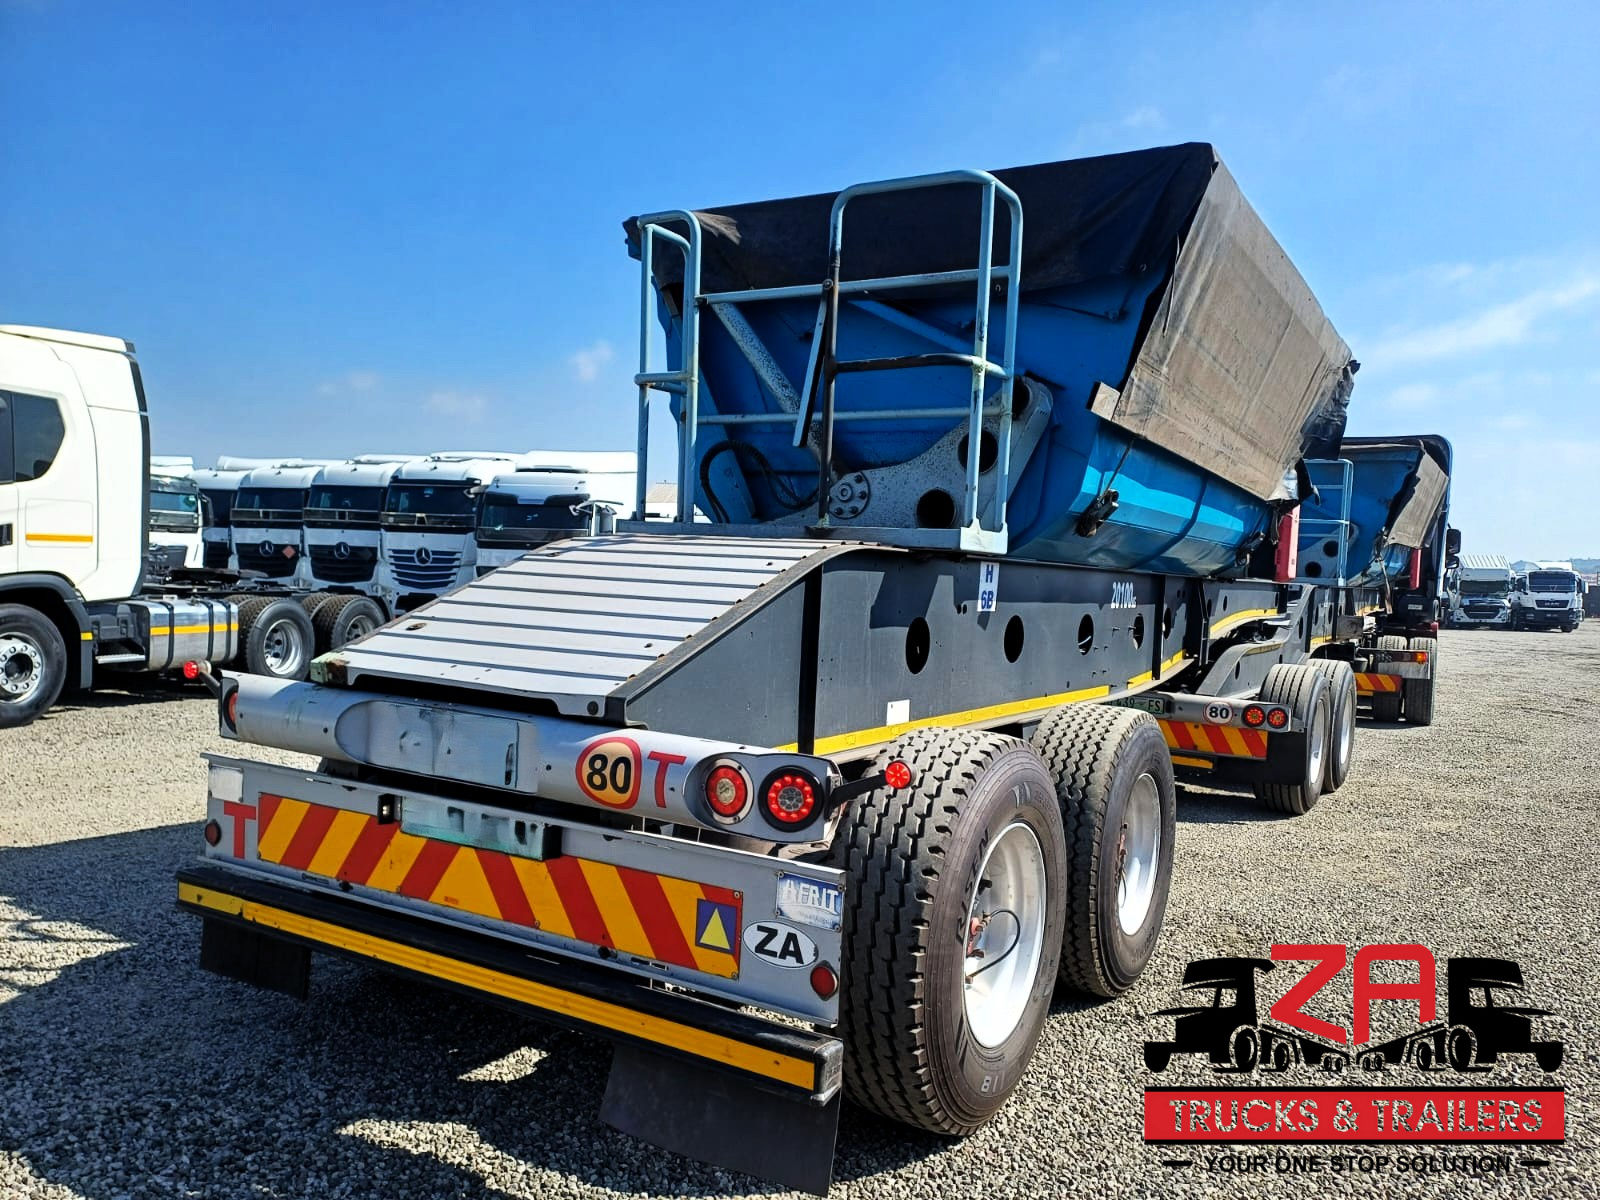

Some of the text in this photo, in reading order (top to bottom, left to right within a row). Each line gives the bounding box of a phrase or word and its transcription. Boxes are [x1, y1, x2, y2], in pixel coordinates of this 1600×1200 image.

[985, 564, 994, 583] H
[981, 590, 994, 610] 6B
[1148, 699, 1161, 712] FS
[1209, 706, 1230, 719] 80
[587, 750, 687, 808] 80 T
[223, 800, 257, 859] T
[754, 924, 805, 965] ZA
